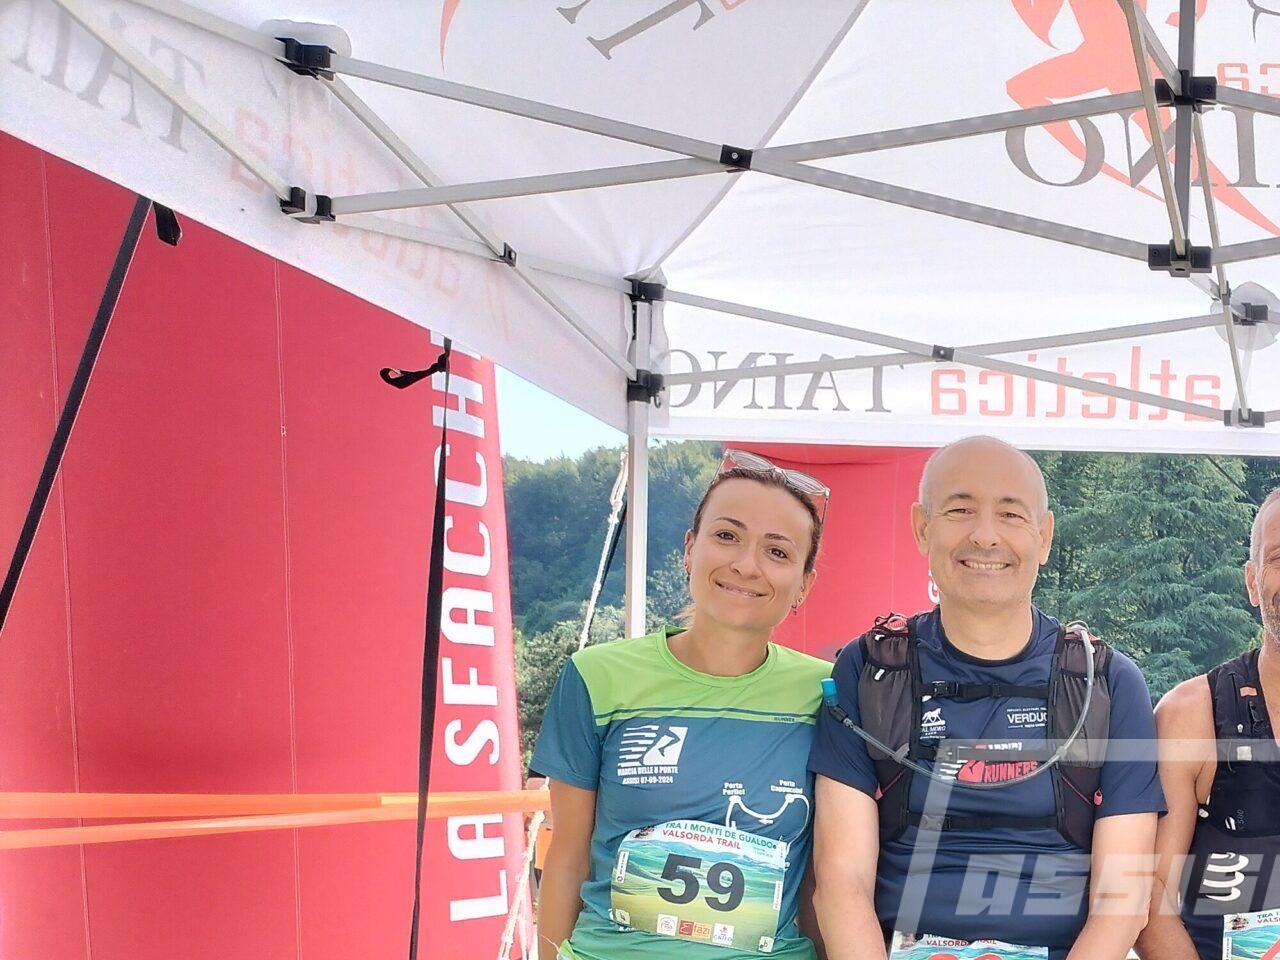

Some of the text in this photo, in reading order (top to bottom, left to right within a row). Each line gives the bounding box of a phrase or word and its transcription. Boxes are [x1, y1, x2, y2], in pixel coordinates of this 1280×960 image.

[659, 766, 679, 774] PORTE
[984, 761, 1038, 783] RUNNERS
[662, 829, 741, 850] VALSORDA TRAIL
[665, 822, 681, 830] TRA
[690, 824, 722, 836] MONTI
[725, 830, 737, 840] DE
[739, 835, 773, 849] GUALDO
[447, 812, 508, 922] LA
[657, 853, 746, 912] 59
